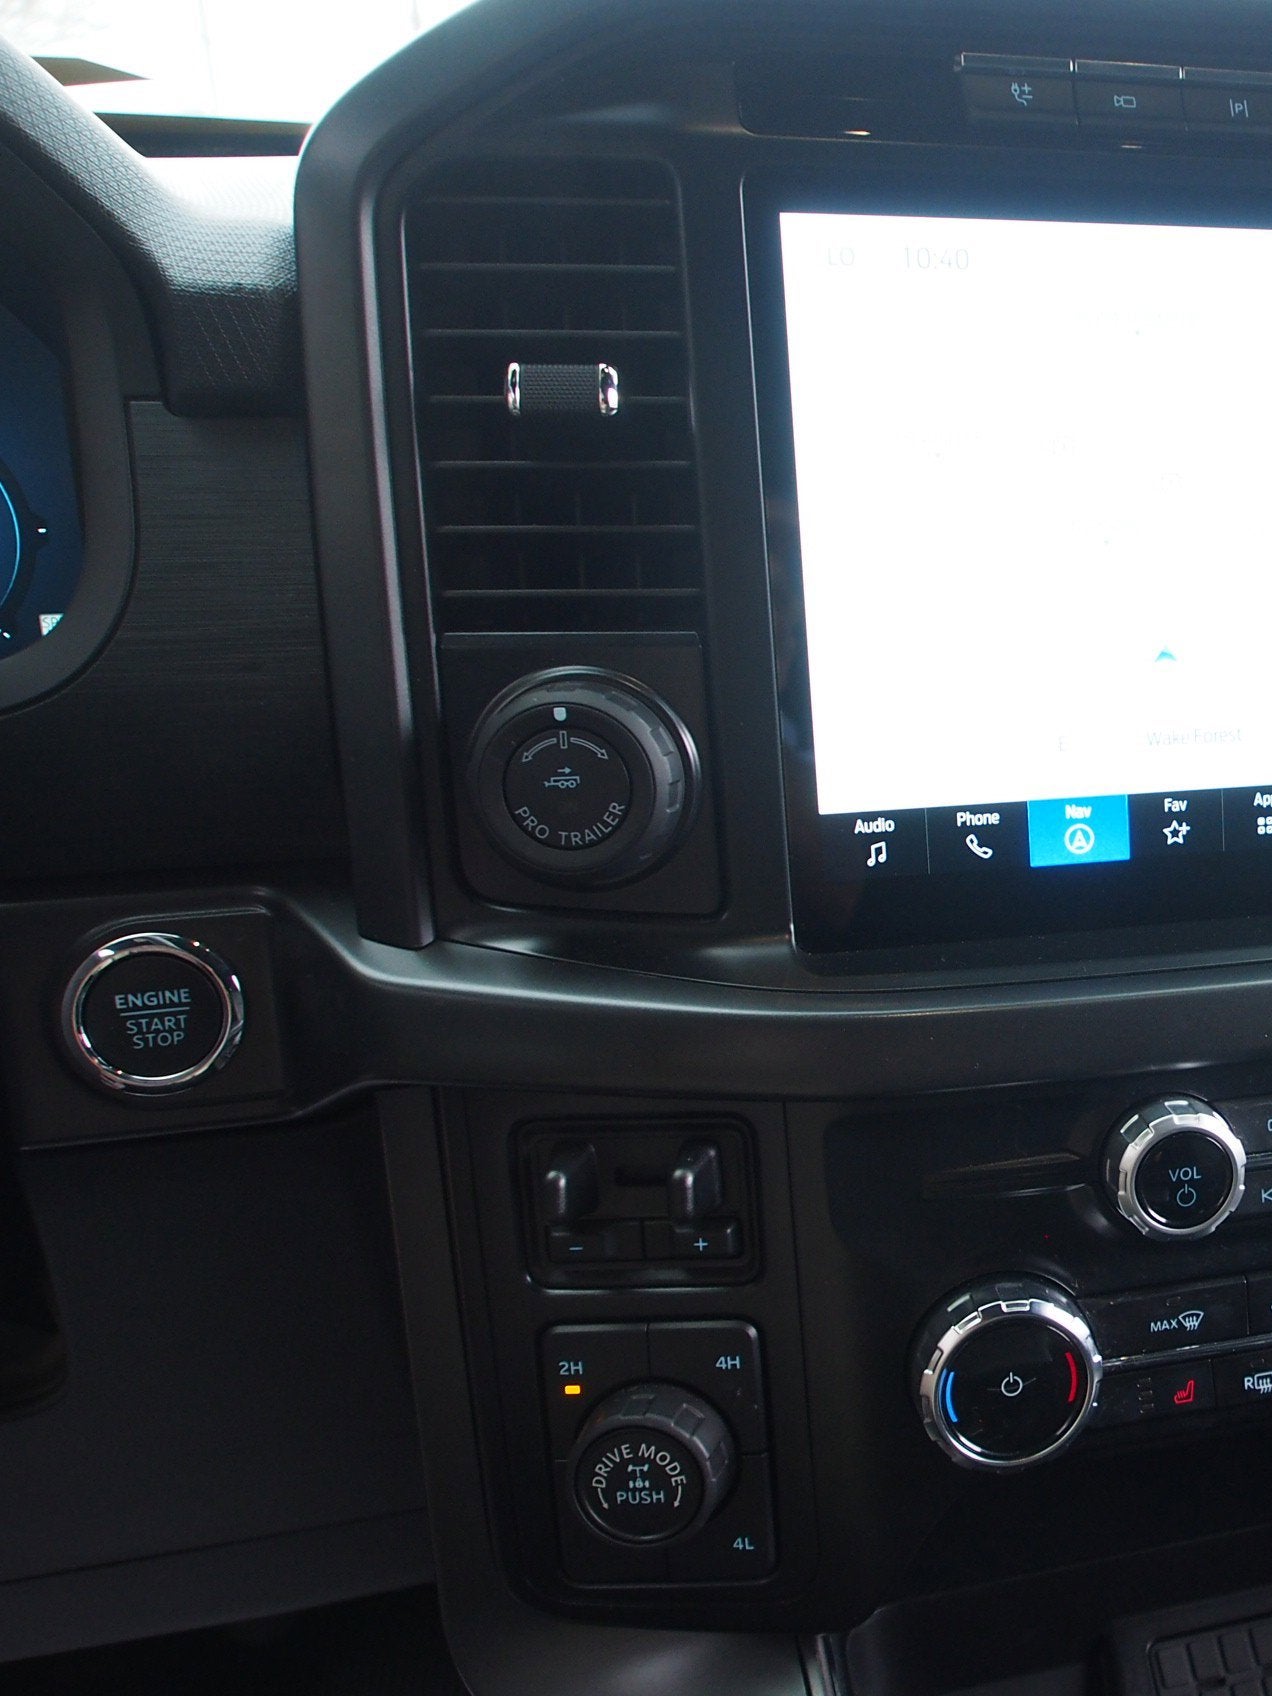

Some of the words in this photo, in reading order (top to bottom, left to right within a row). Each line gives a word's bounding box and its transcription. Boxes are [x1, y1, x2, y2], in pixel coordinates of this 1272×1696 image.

[904, 245, 969, 270] 10:40
[1193, 727, 1244, 744] Forest
[1065, 804, 1092, 819] Nav
[1164, 798, 1188, 813] Fav
[515, 806, 549, 839] PRO
[558, 801, 626, 846] TRAILER
[854, 817, 895, 834] Audio
[956, 811, 1000, 827] Phone
[115, 989, 192, 1009] ENGINE
[126, 1015, 187, 1034] START
[132, 1031, 184, 1049] STOP
[1169, 1166, 1202, 1181] VOL
[1150, 1319, 1178, 1332] MAX
[558, 1361, 583, 1376] 2H
[715, 1355, 741, 1370] 4H
[592, 1444, 634, 1488] DRIVE
[638, 1443, 686, 1487] MODE
[616, 1490, 665, 1505] PUSH
[733, 1537, 754, 1551] 4L
